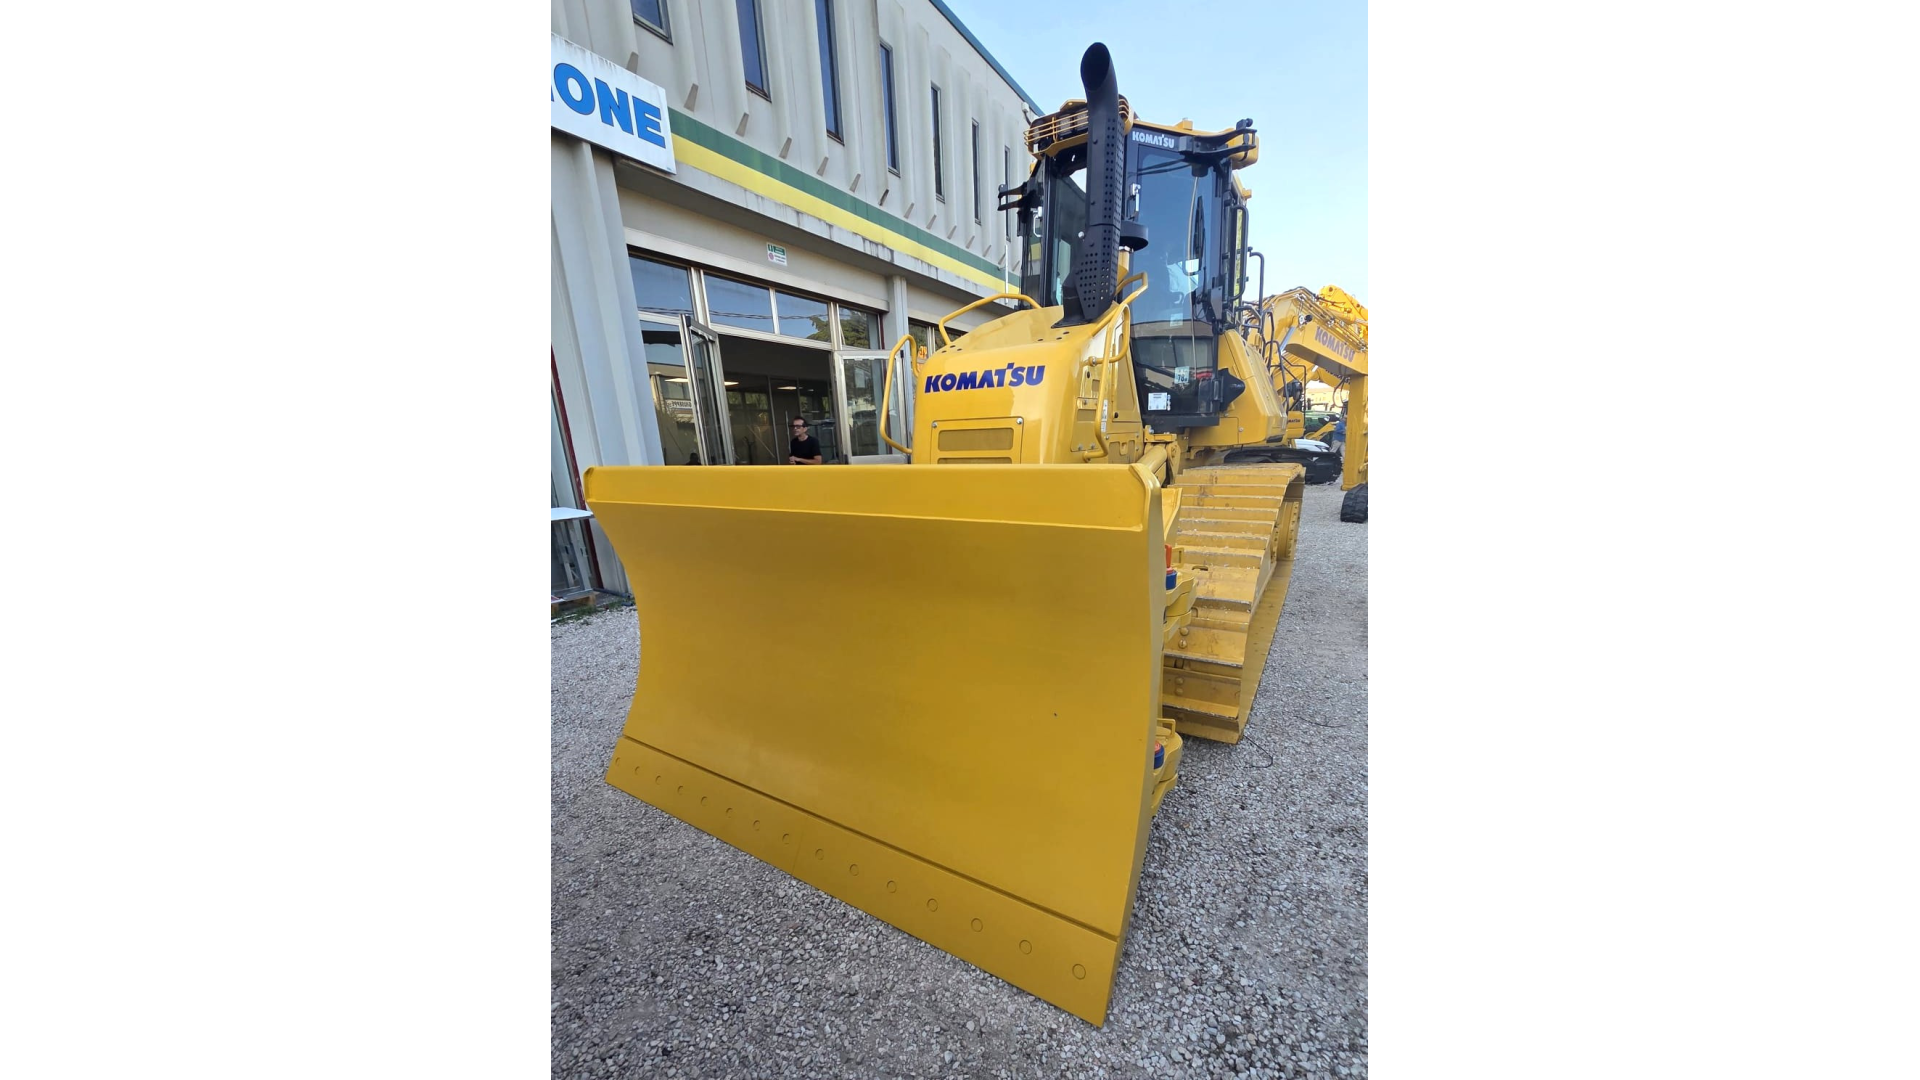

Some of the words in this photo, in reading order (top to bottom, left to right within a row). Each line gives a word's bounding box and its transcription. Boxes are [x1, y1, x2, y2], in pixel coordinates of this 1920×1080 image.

[551, 63, 666, 149] ONE
[1132, 131, 1175, 148] KOMATSU
[1315, 326, 1355, 362] KOMATSU
[924, 362, 1046, 393] KOMATSU
